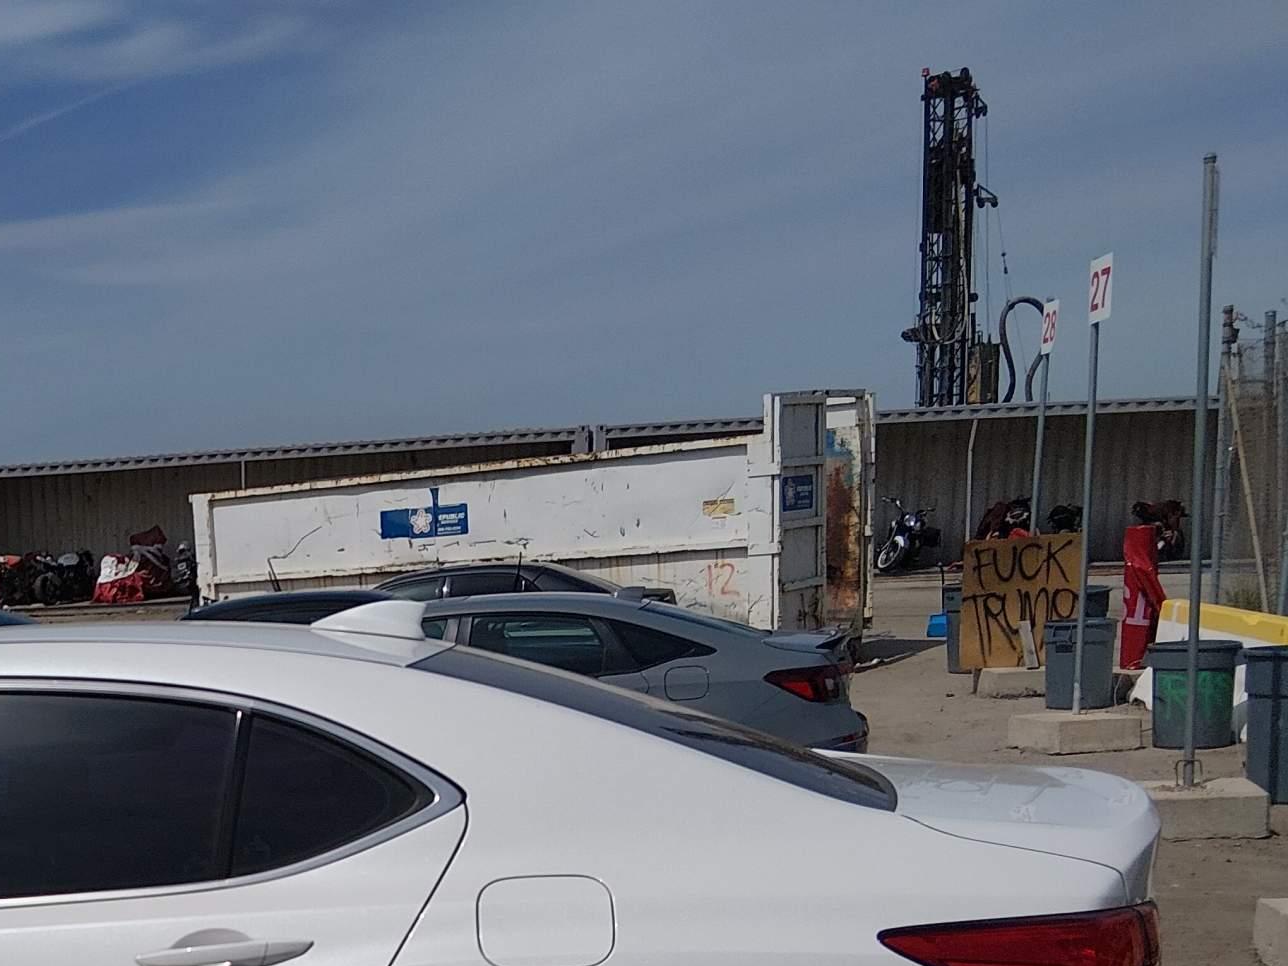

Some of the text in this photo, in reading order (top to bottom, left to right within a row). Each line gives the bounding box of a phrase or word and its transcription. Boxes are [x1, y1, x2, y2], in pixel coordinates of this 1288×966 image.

[1090, 266, 1111, 312] 27
[1042, 310, 1057, 344] 28
[707, 563, 740, 595] 12
[972, 539, 1073, 590] FUCK
